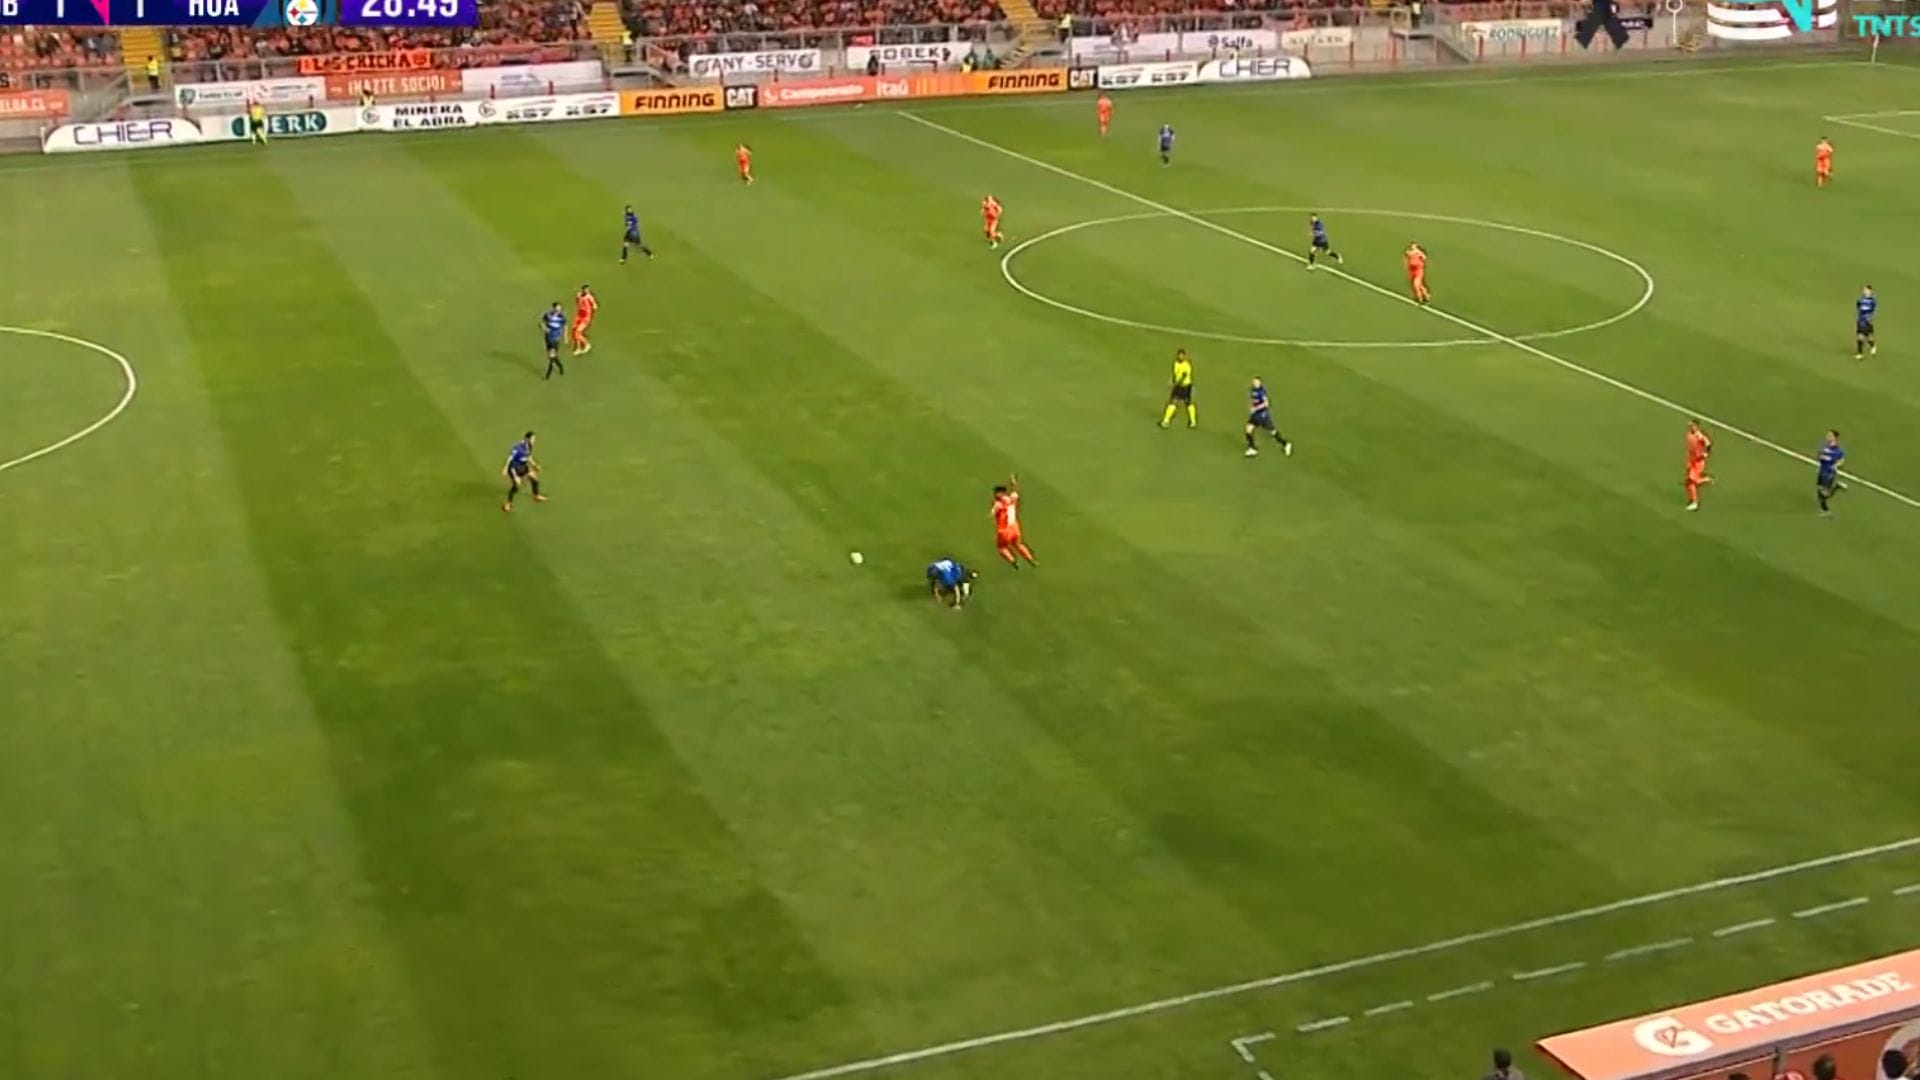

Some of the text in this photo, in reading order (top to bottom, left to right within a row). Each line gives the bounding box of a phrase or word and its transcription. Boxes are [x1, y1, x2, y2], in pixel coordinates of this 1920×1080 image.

[988, 73, 1059, 89] FINNING
[1070, 69, 1094, 87] CAT
[726, 87, 754, 108] CAT
[780, 84, 864, 100] Campeonato
[395, 104, 463, 116] MINERA
[634, 93, 715, 110] FINNING
[393, 115, 467, 128] EL ABRA
[73, 121, 173, 145] CHIER
[1706, 972, 1912, 1034] GATORADE
